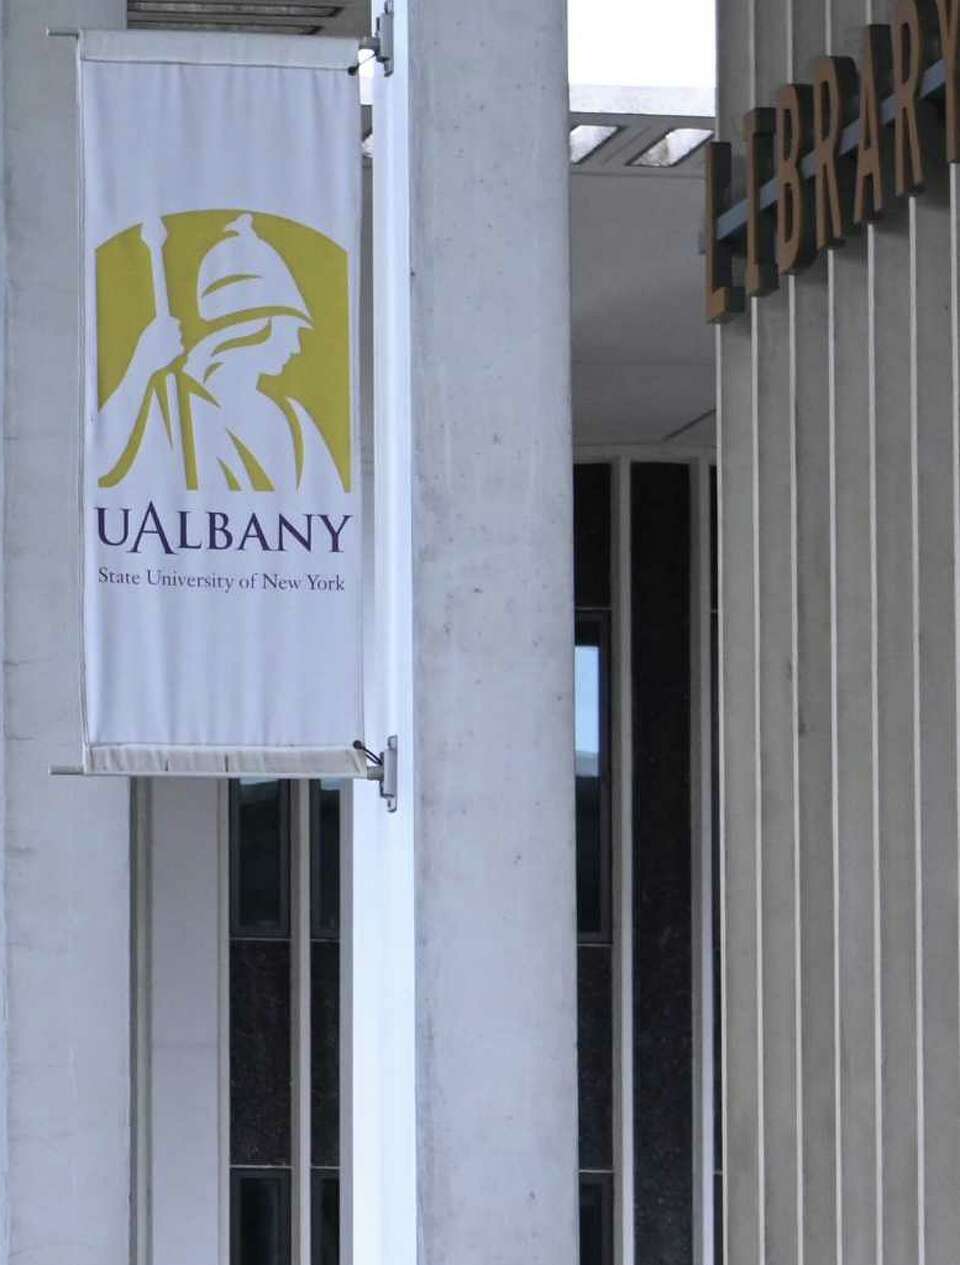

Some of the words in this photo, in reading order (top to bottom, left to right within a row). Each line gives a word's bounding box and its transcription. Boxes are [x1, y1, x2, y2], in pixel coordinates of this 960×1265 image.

[705, 0, 960, 323] LIBRARY
[94, 500, 354, 555] UALBANY
[98, 567, 140, 585] State
[147, 569, 234, 593] University
[239, 573, 258, 590] of
[262, 573, 299, 590] New
[307, 574, 345, 591] York
